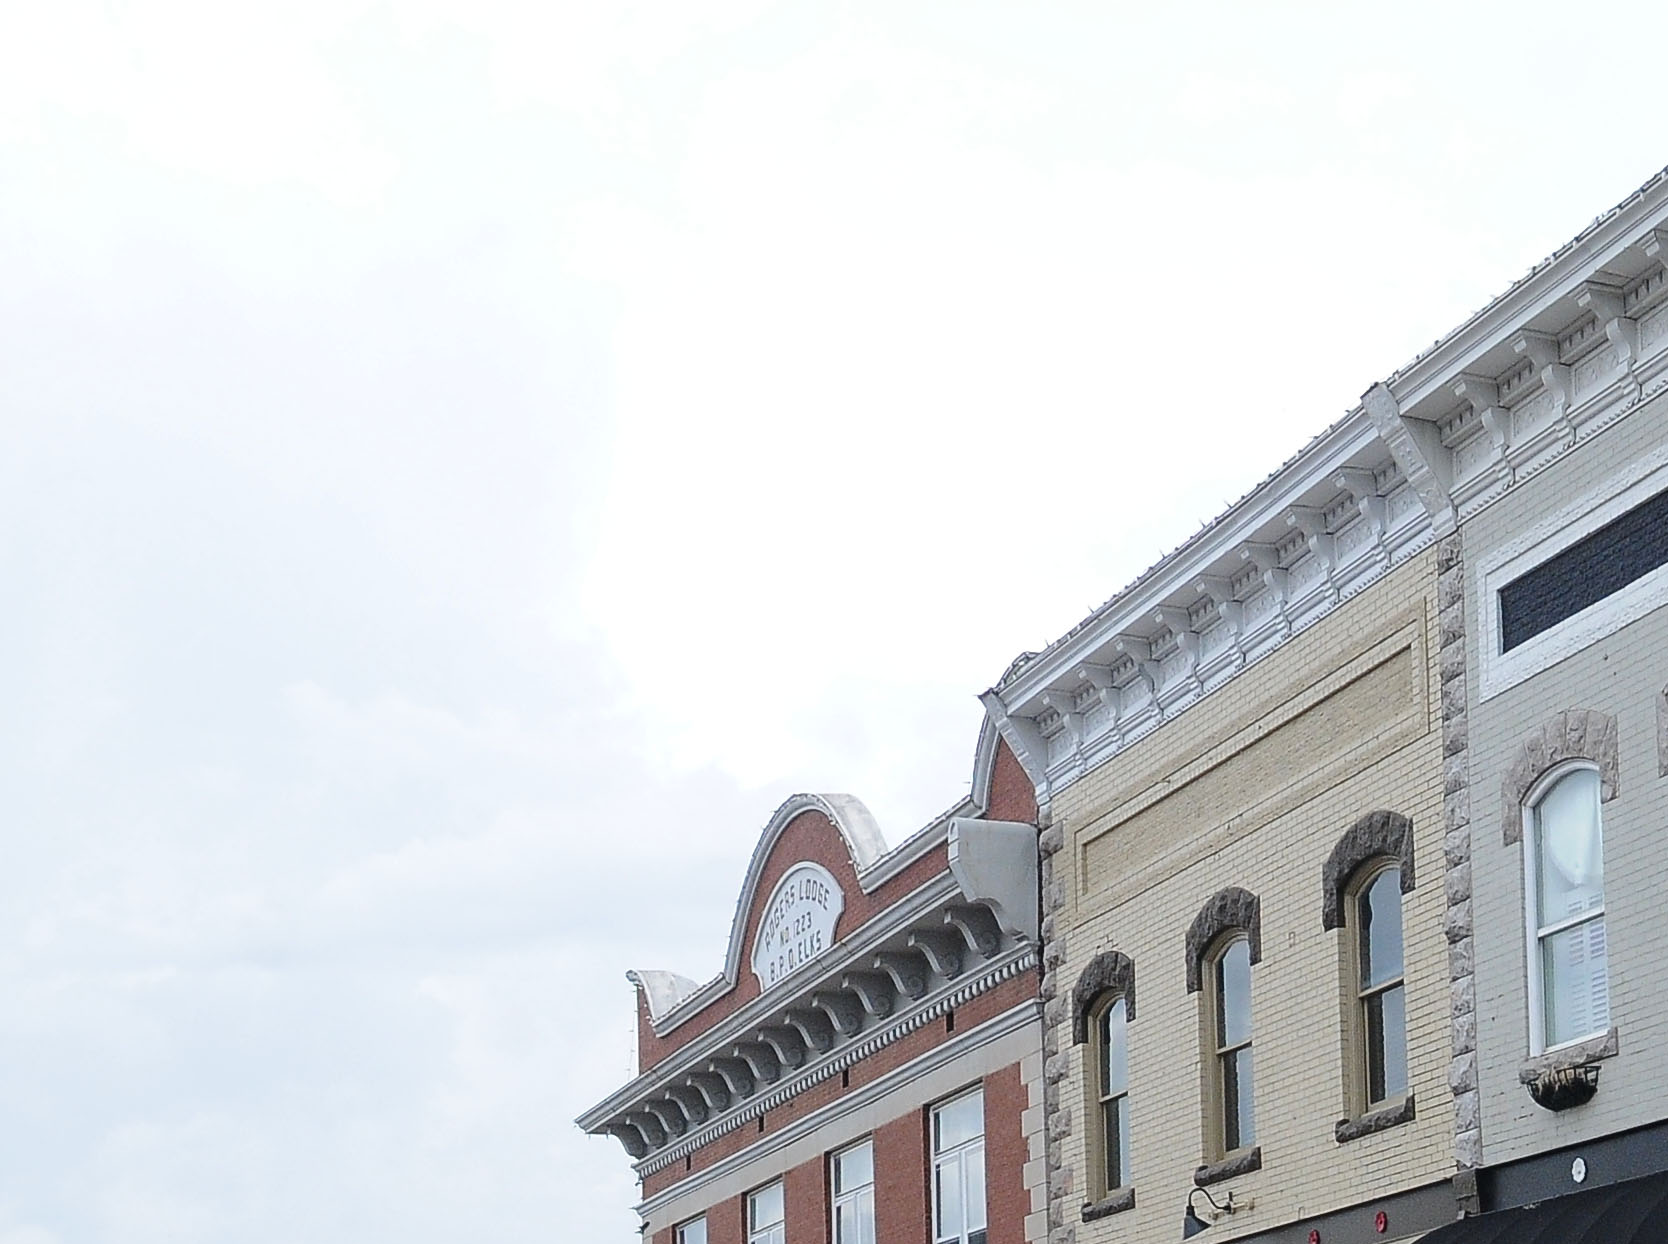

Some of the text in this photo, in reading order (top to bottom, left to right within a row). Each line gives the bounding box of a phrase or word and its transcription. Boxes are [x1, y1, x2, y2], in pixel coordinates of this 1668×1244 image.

[764, 878, 830, 952] ROGERS LODGE
[793, 911, 812, 938] 1223
[798, 929, 822, 962] ELKS
